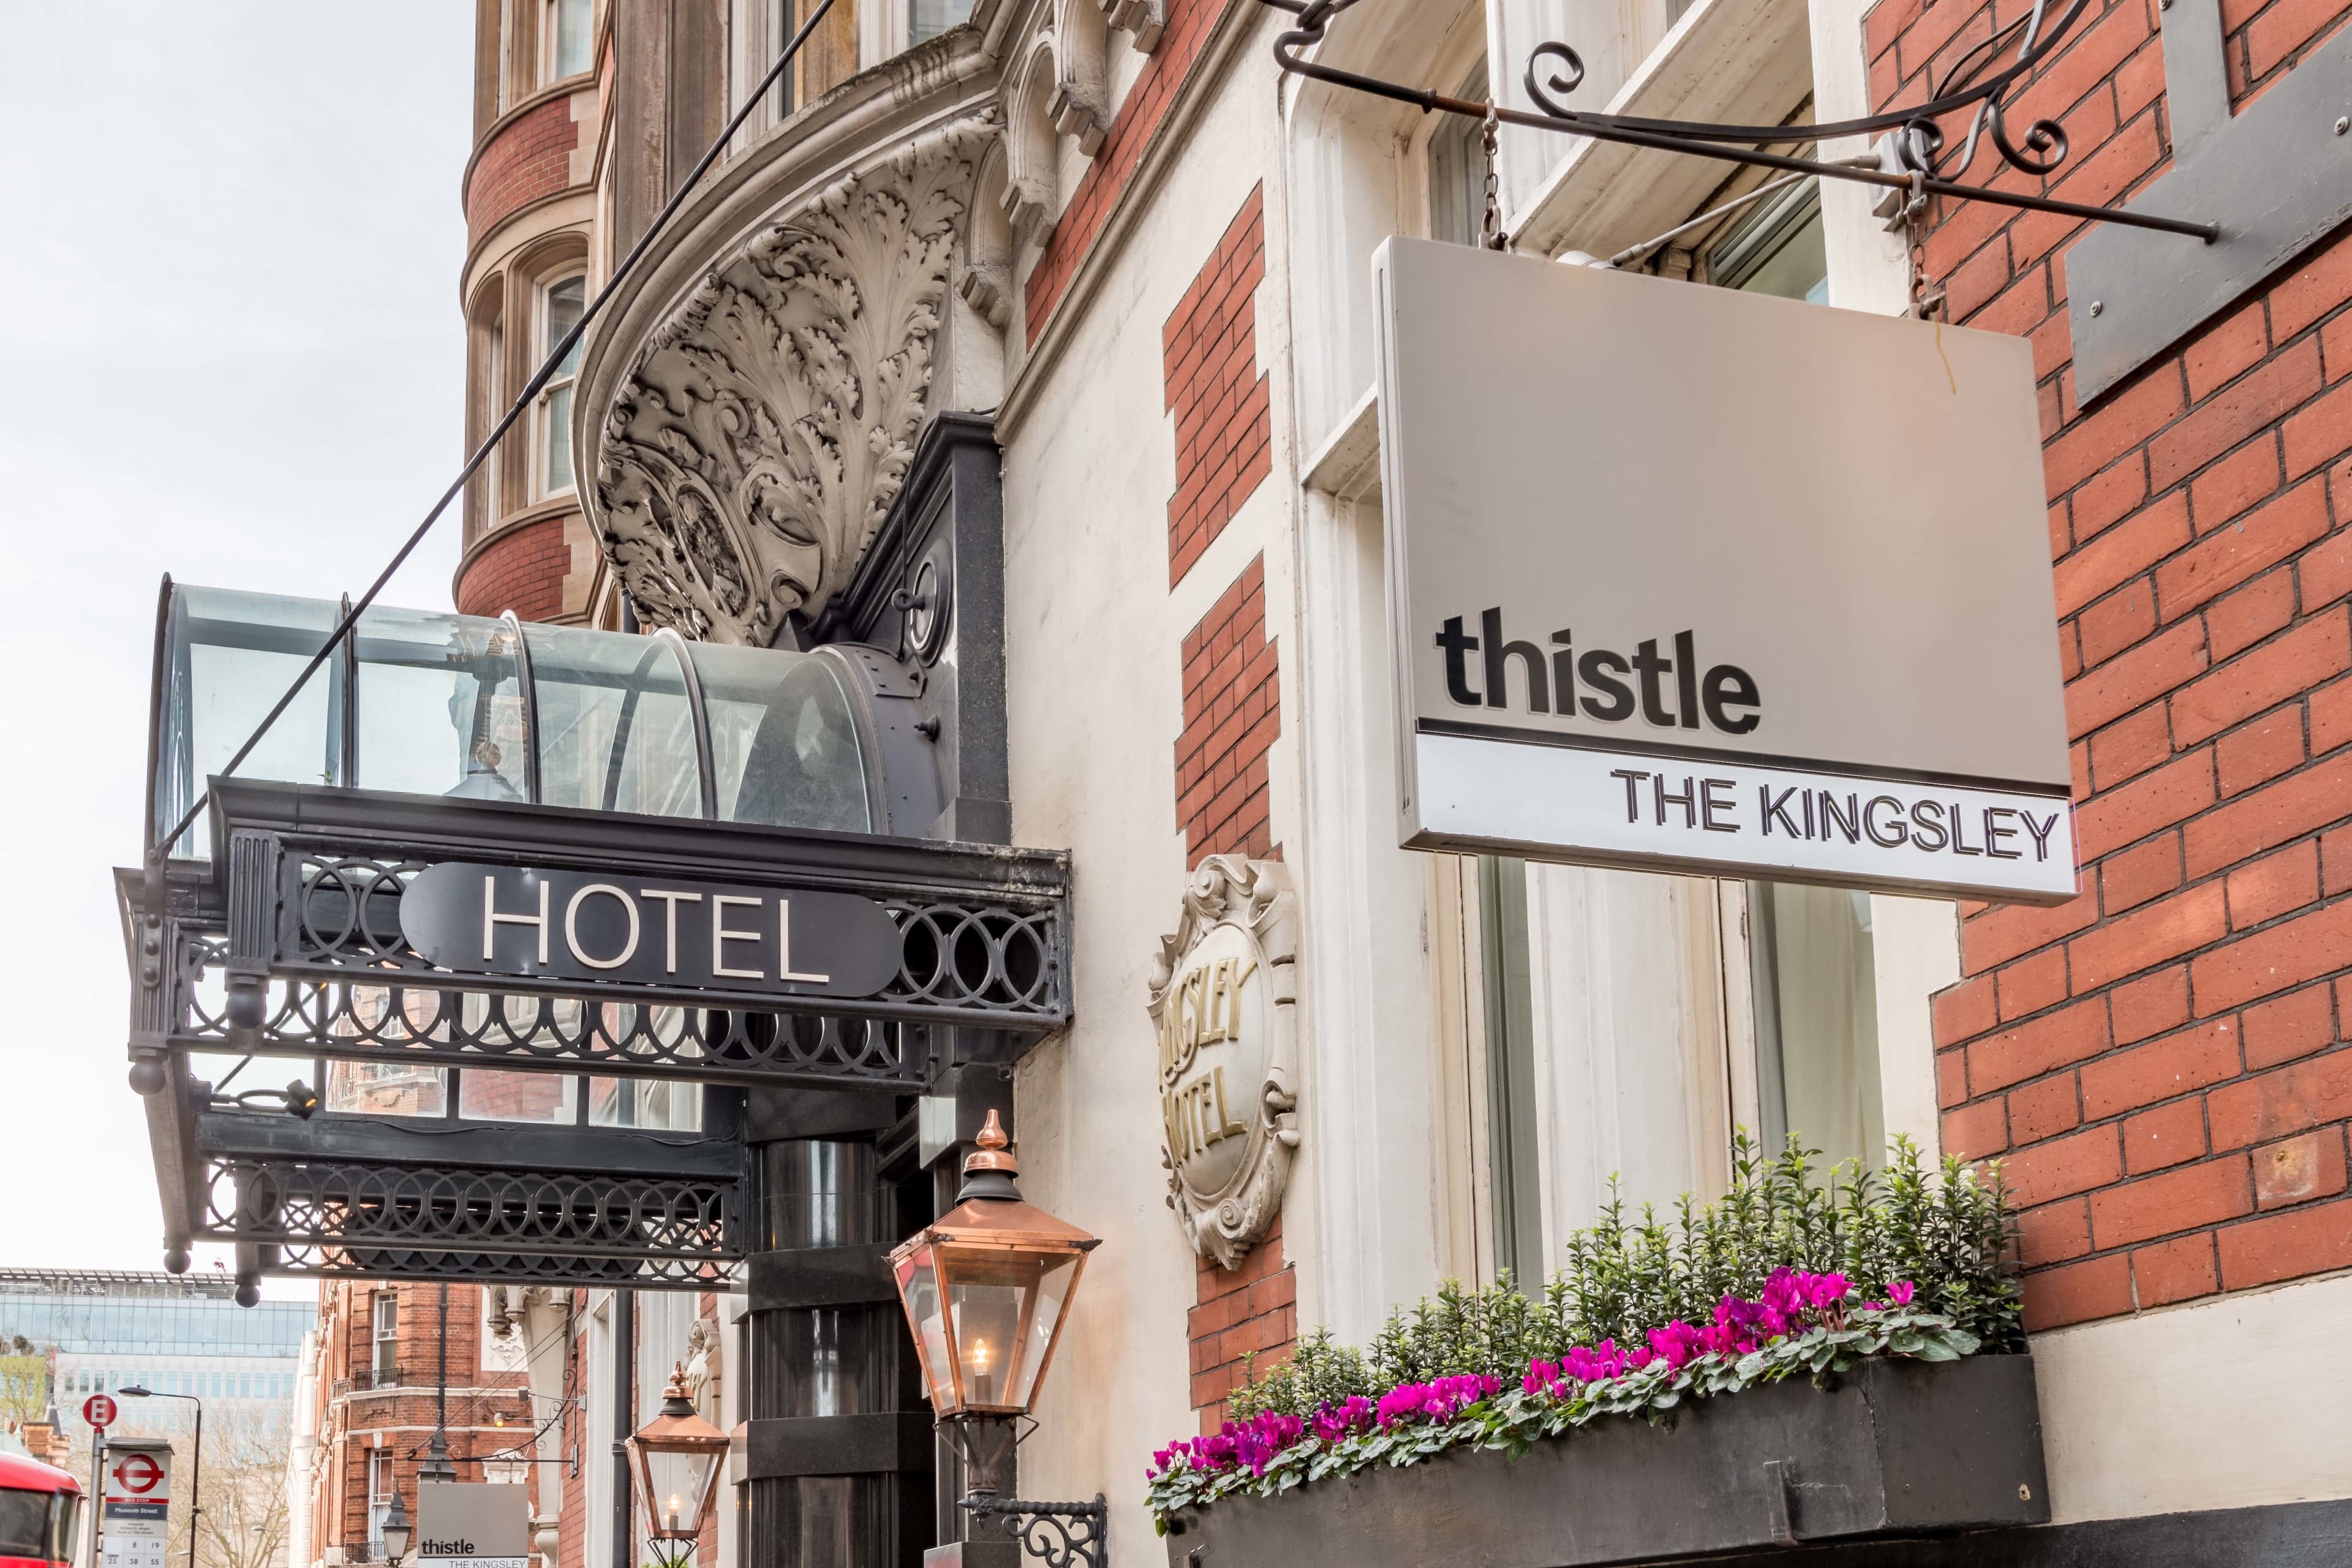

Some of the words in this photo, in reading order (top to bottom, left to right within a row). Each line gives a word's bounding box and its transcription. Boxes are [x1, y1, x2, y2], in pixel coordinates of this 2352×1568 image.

[1433, 606, 1762, 735] thistle
[1610, 769, 1741, 832] THE
[1759, 783, 2060, 862] KINGSLEY
[483, 876, 829, 983] HOTEL
[1162, 1066, 1248, 1169] HOTEL
[91, 1400, 108, 1423] E
[421, 1539, 475, 1555] thistle
